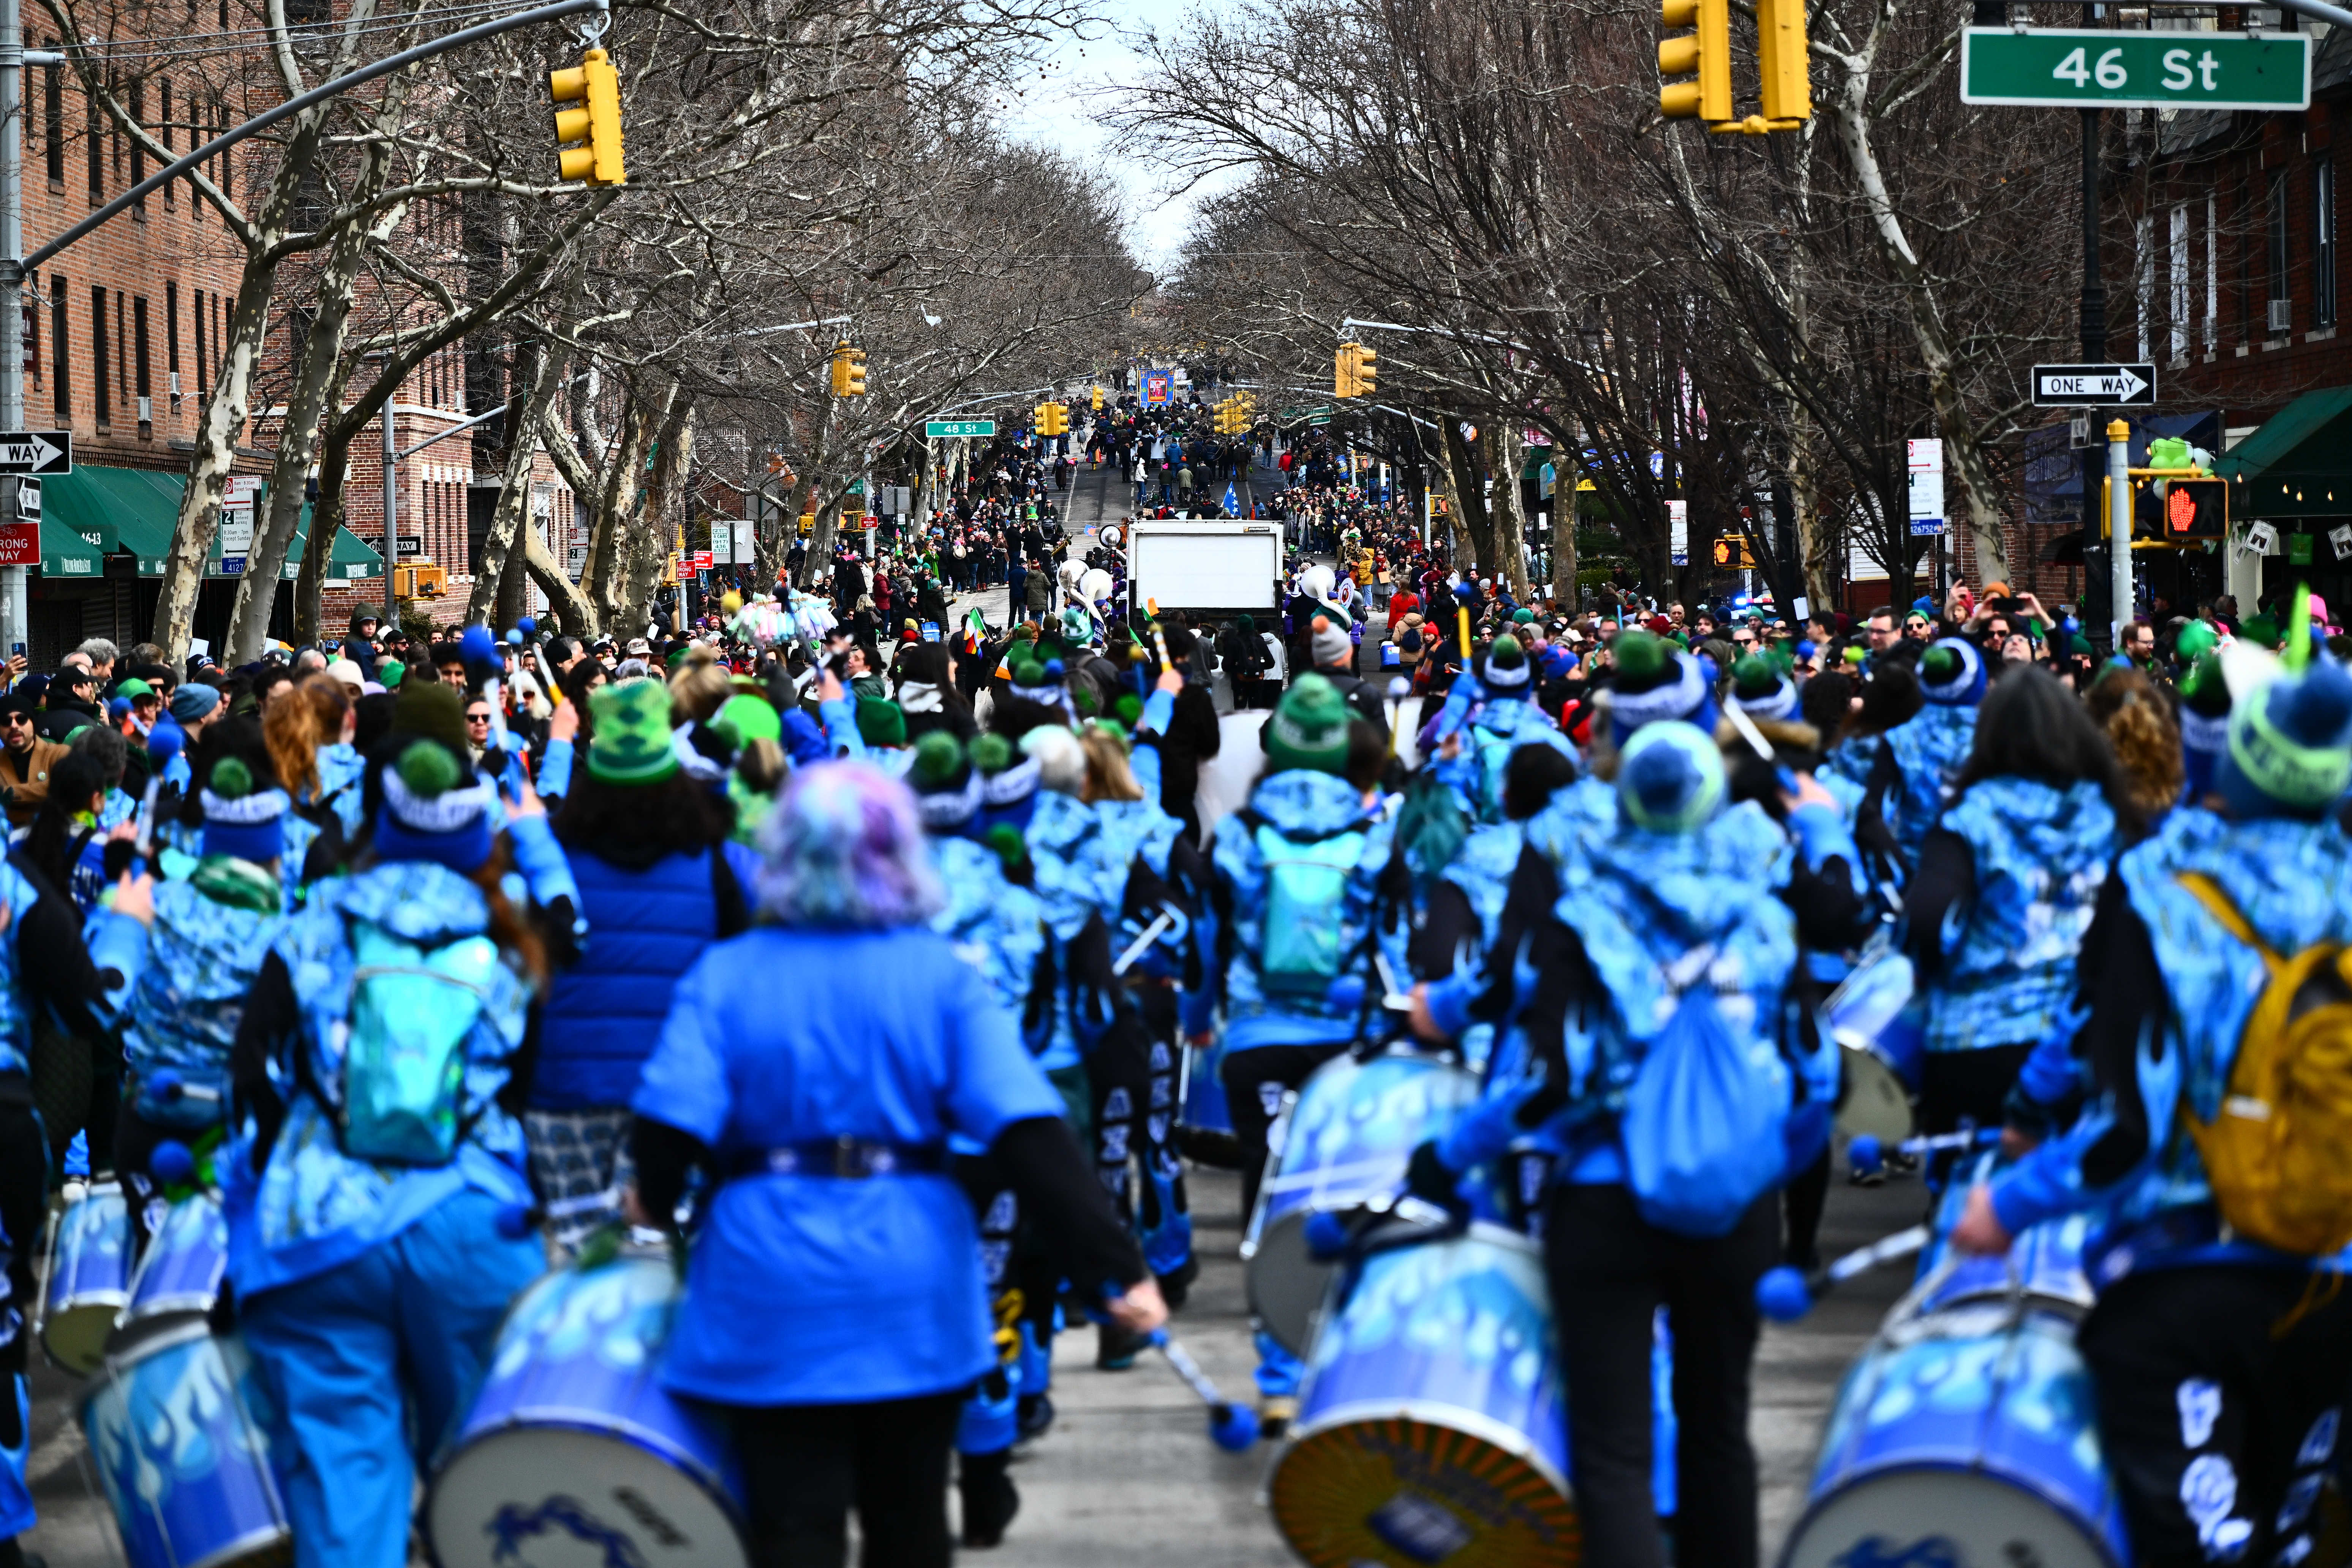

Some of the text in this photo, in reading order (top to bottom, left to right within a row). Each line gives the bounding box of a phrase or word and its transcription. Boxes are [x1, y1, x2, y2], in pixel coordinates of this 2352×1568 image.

[2053, 47, 2219, 91] 46 St
[2051, 378, 2135, 393] ONE WAY
[944, 424, 977, 433] 48 St
[8, 446, 44, 461] WAY
[225, 511, 231, 523] 2
[572, 549, 575, 558] 2
[228, 564, 243, 572] 4127
[285, 563, 295, 578] FRESH
